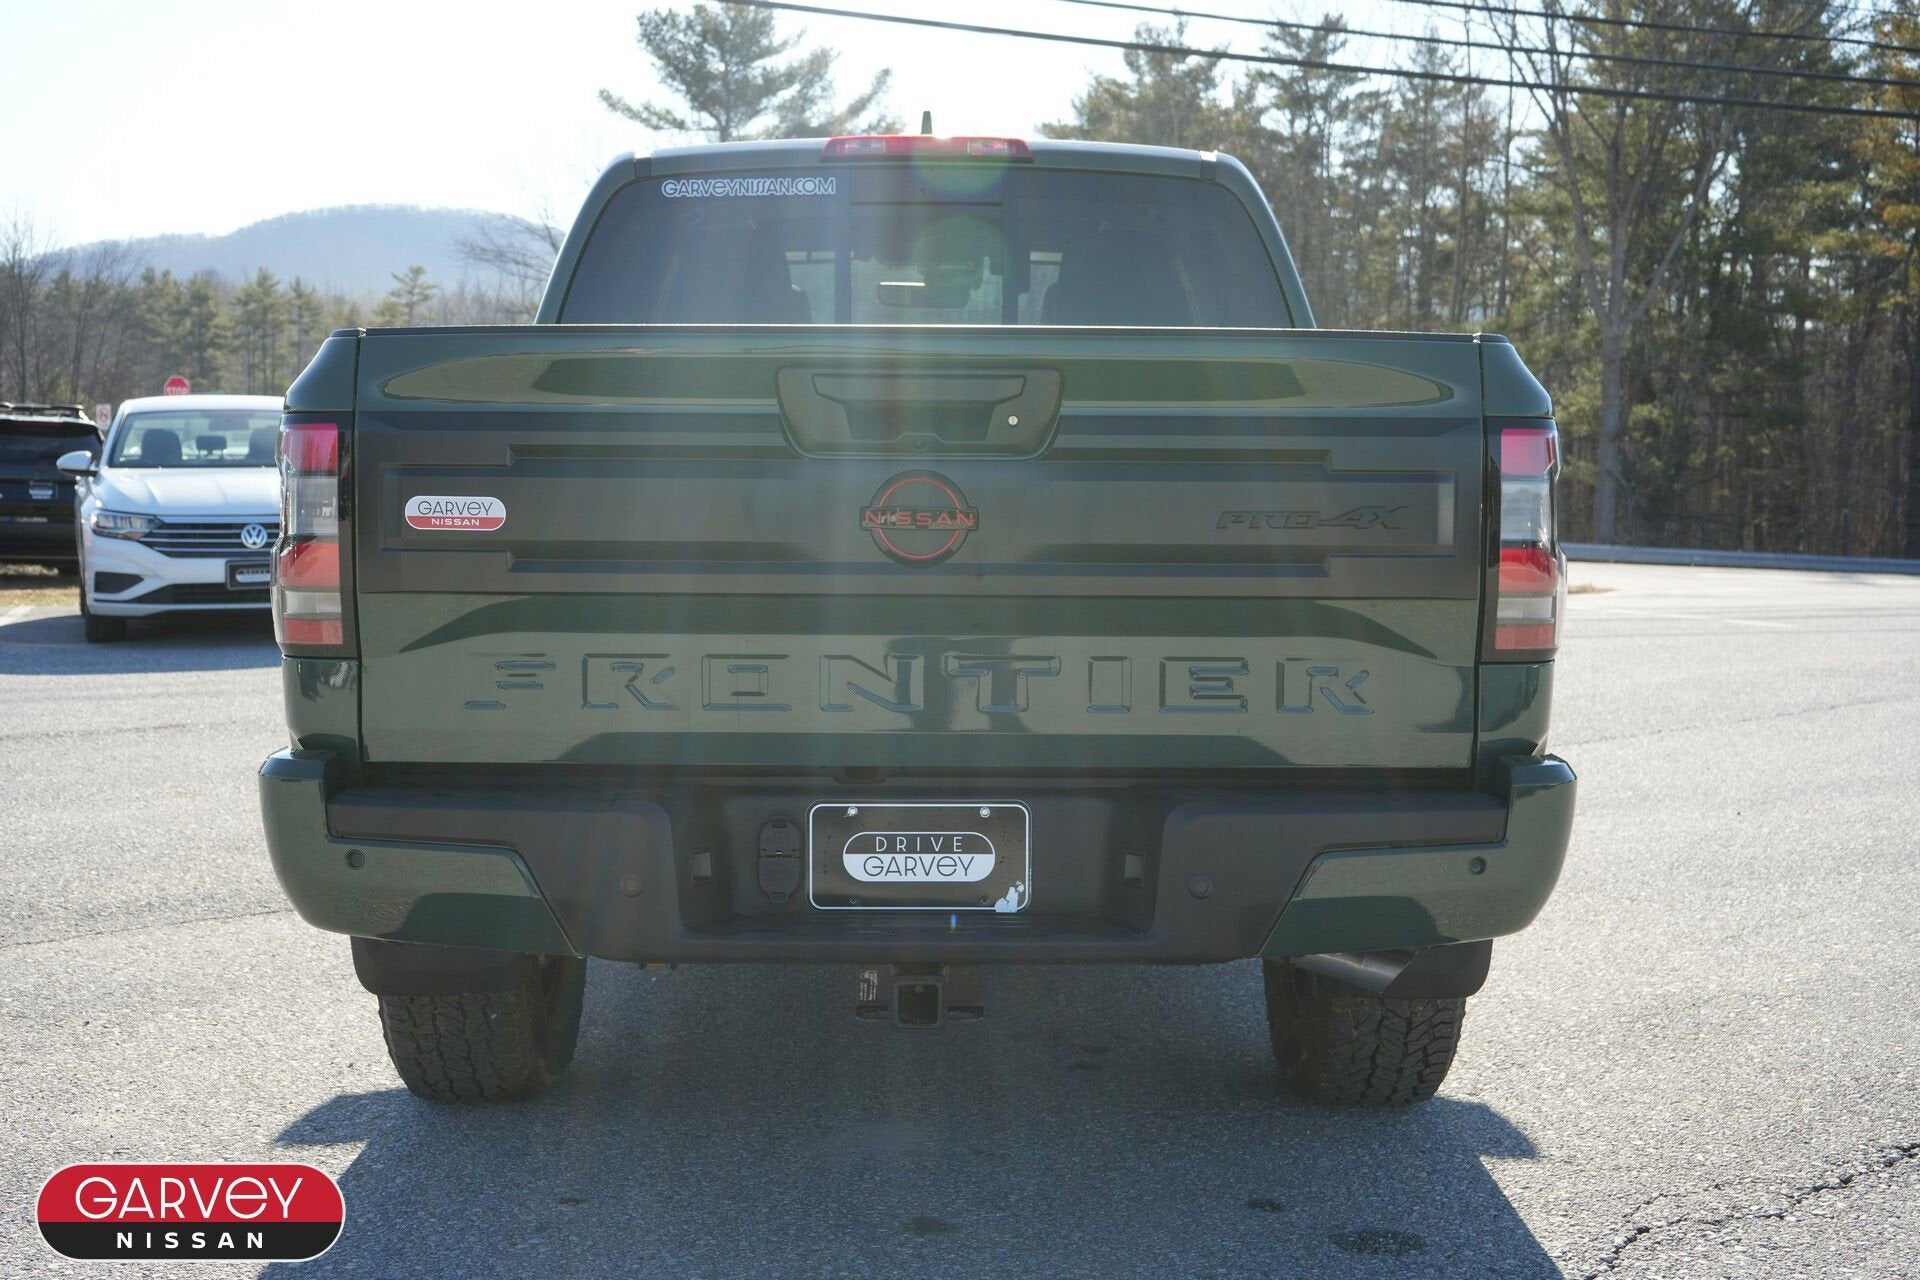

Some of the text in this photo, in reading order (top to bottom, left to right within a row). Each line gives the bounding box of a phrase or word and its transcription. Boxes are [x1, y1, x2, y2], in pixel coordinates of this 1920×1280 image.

[662, 177, 836, 198] GARVEYNISSAN.COM
[417, 500, 493, 516] GARVEY
[1215, 505, 1410, 530] PRO-4X
[431, 518, 480, 526] NISSAN
[864, 510, 976, 527] NISSAN
[463, 652, 1375, 714] FRONTIER
[875, 836, 963, 852] DRIVE
[863, 855, 975, 877] GARVEY
